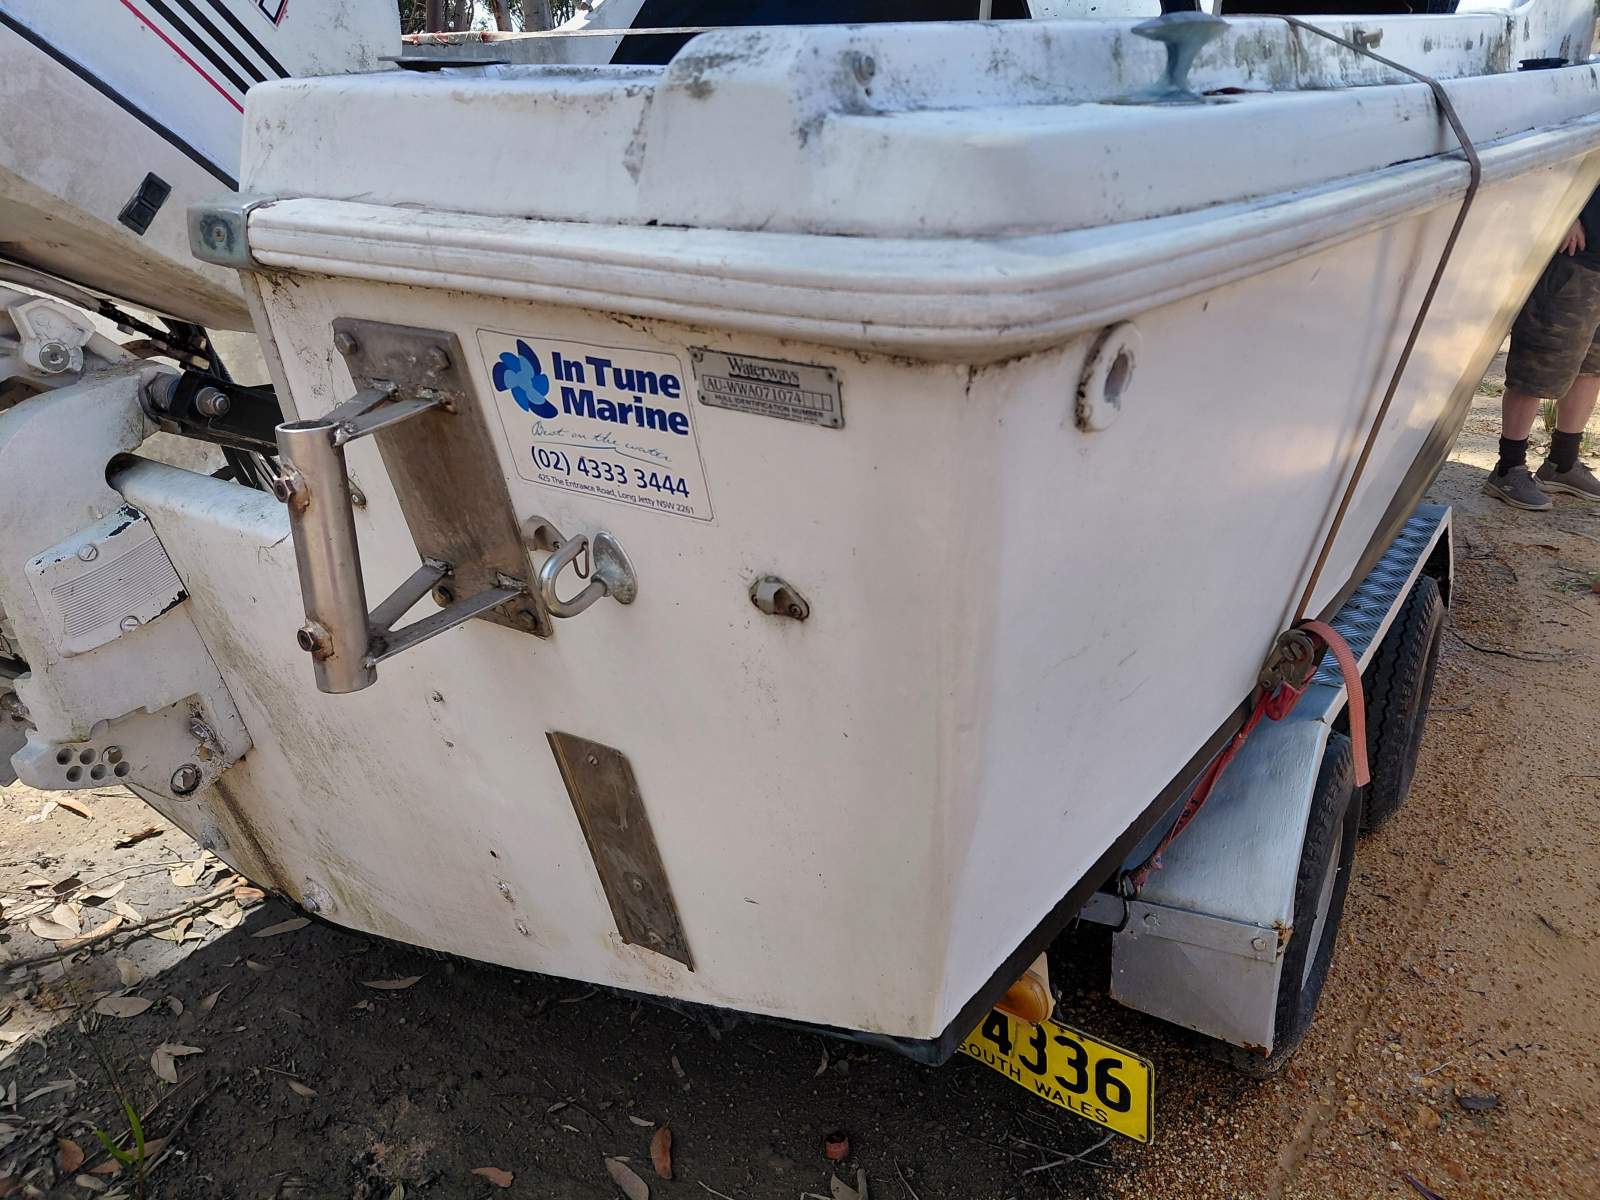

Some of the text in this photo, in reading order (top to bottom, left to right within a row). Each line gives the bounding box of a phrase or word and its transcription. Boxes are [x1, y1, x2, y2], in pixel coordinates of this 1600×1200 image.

[726, 356, 800, 384] Waterways
[560, 386, 689, 435] Marine
[531, 420, 569, 437] Best
[571, 432, 586, 440] on
[592, 431, 619, 446] the
[531, 445, 690, 498] (02) 4333 3444
[537, 473, 551, 483] 425
[550, 475, 564, 486] The
[565, 479, 595, 493] Entrance
[595, 486, 617, 498] Road,
[617, 490, 637, 503] Long
[637, 495, 656, 507] Jetty
[656, 499, 675, 511] NSW
[1034, 1079, 1109, 1124] WALES
